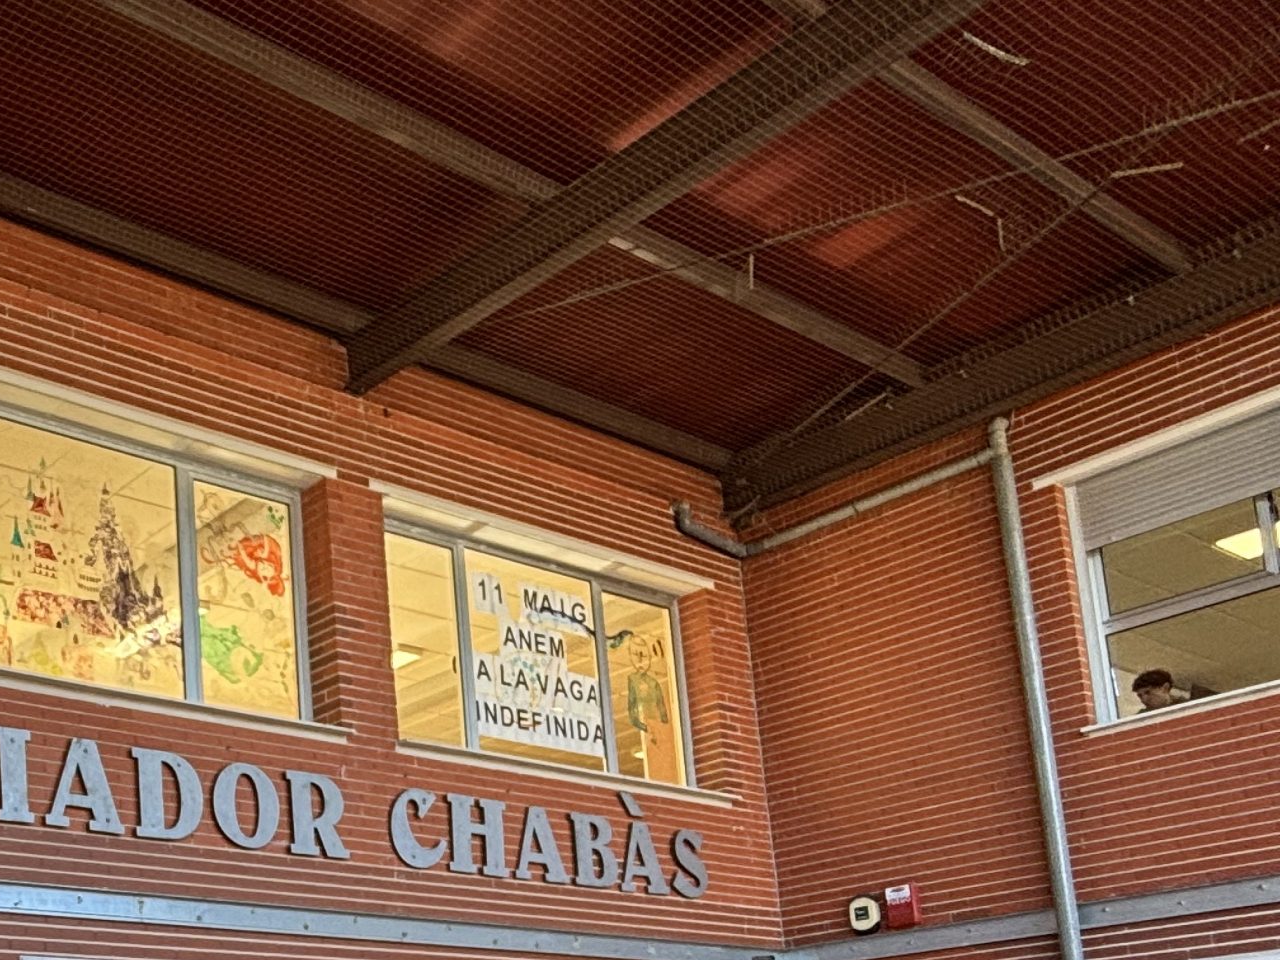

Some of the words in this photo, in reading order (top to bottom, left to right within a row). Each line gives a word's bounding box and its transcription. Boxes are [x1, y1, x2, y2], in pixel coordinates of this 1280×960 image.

[478, 578, 503, 605] 11
[523, 588, 587, 624] MAIG
[503, 625, 565, 659] ANEM
[477, 659, 492, 682] A
[499, 663, 529, 691] LA
[536, 673, 598, 706] VAGA
[475, 700, 605, 744] INDEFINIDA
[389, 787, 709, 898] CHABÀS
